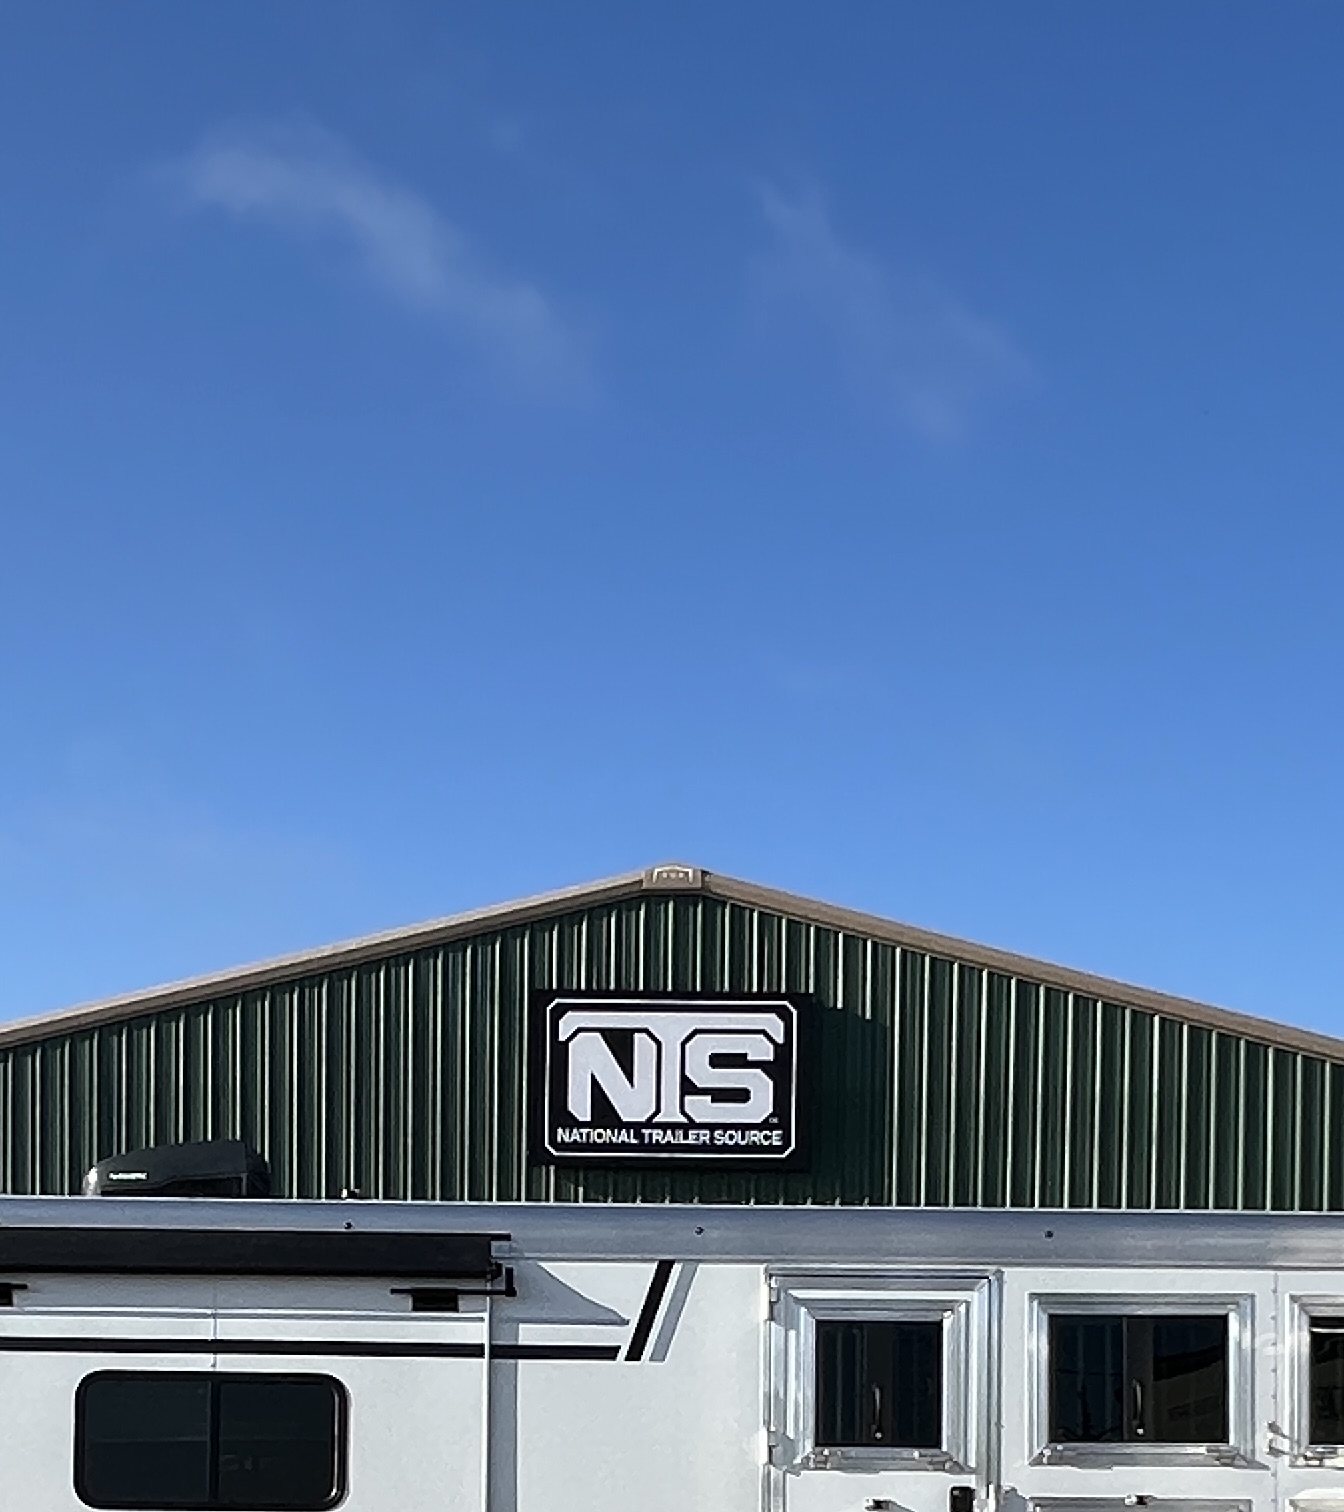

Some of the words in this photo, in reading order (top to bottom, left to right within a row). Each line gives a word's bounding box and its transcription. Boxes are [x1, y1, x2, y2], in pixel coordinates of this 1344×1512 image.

[558, 1010, 785, 1123] NTS
[556, 1127, 639, 1145] NATIONAL
[641, 1128, 710, 1146] TRAILER
[713, 1129, 784, 1146] SOURCE
